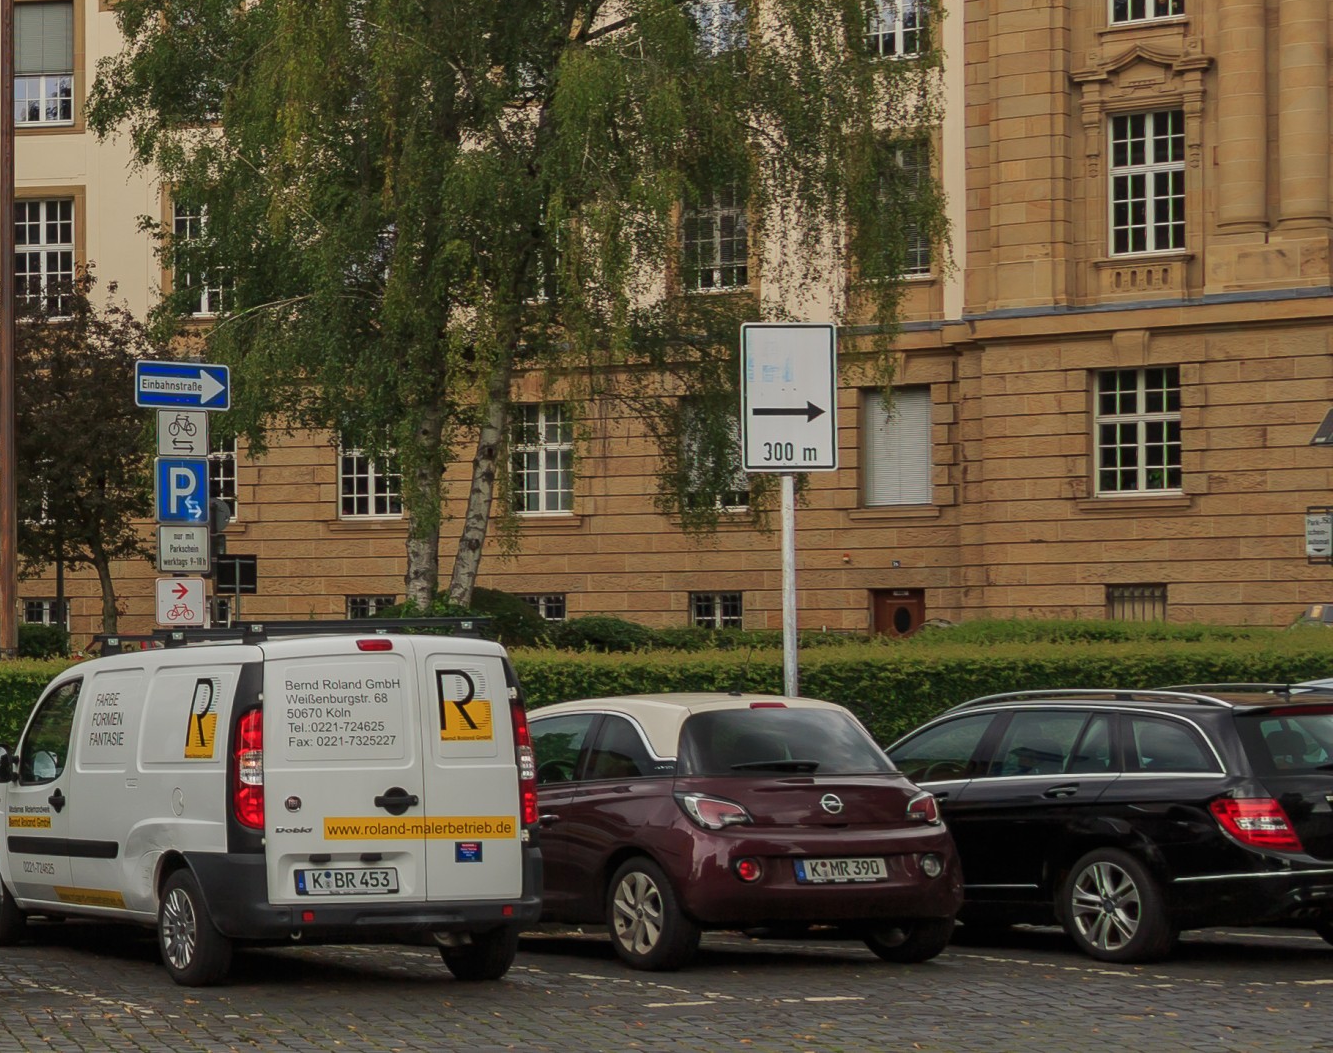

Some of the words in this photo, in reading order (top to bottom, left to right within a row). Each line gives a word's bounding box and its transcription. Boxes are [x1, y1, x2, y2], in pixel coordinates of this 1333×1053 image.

[141, 379, 202, 392] Einbahnstraße
[763, 442, 794, 461] 300
[803, 447, 817, 461] m
[170, 467, 196, 513] P
[169, 544, 199, 553] Parkschein
[163, 557, 188, 567] werktags
[285, 680, 318, 690] Bernd
[322, 679, 362, 690] Roland
[365, 678, 401, 689] GmbH
[95, 692, 120, 706] FARBE
[286, 693, 371, 705] Weißenburgstr.
[374, 693, 388, 703] 68
[92, 712, 124, 726] FORMEN
[286, 708, 322, 719] 50670
[326, 707, 351, 718] Köln
[89, 731, 124, 746] FANTASIE
[288, 736, 313, 747] Fax:
[316, 735, 396, 747] 0221-7325227
[326, 821, 512, 836] www.roland-malerbetrieb.de
[809, 862, 821, 877] K
[851, 860, 880, 876] 390
[311, 872, 323, 888] K
[334, 872, 356, 888] BR
[360, 871, 390, 888] 453
